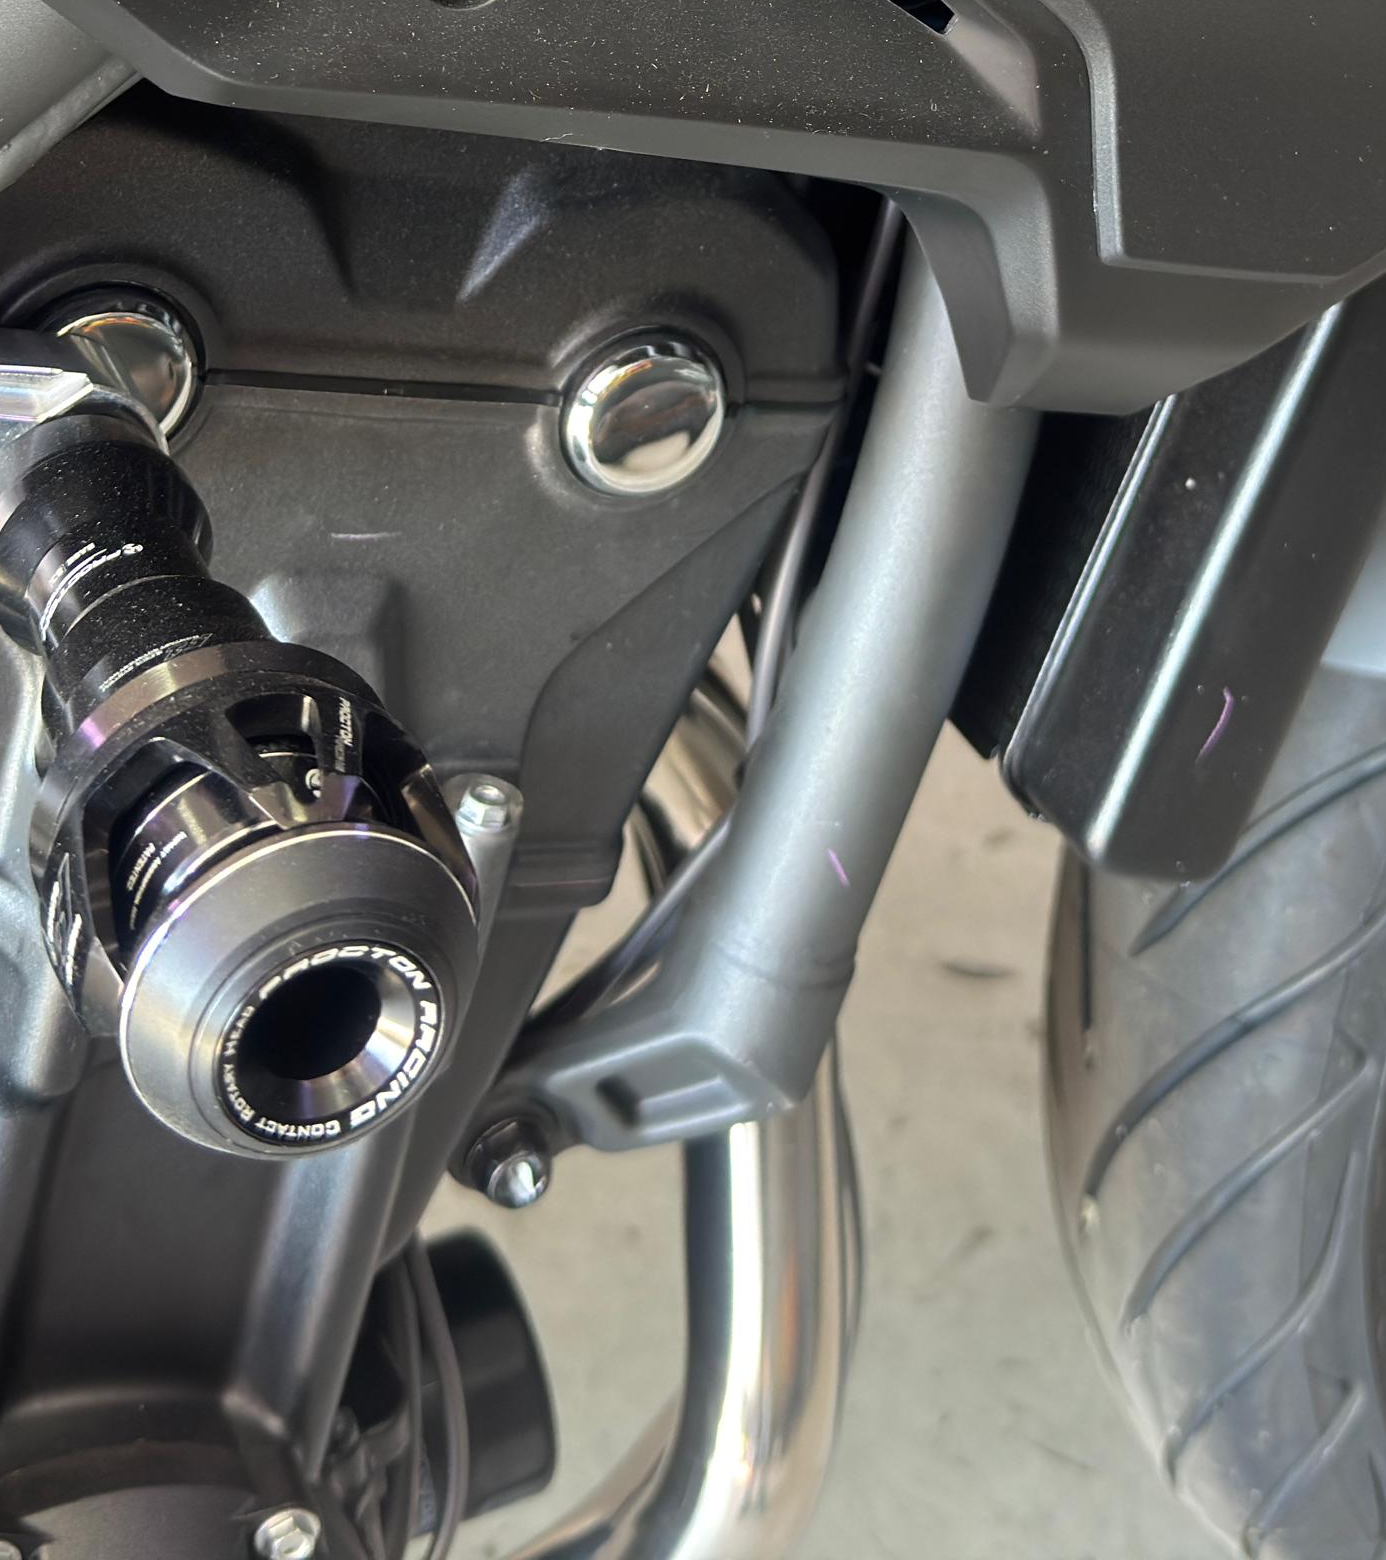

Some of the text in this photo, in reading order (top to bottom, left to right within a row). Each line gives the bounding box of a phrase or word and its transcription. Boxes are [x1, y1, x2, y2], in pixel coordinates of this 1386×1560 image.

[338, 696, 353, 747] PROCTON
[126, 842, 155, 892] PATENTED
[258, 945, 433, 1000] PROCTON
[350, 1000, 438, 1129] RACING
[255, 1116, 341, 1138] CONTACT
